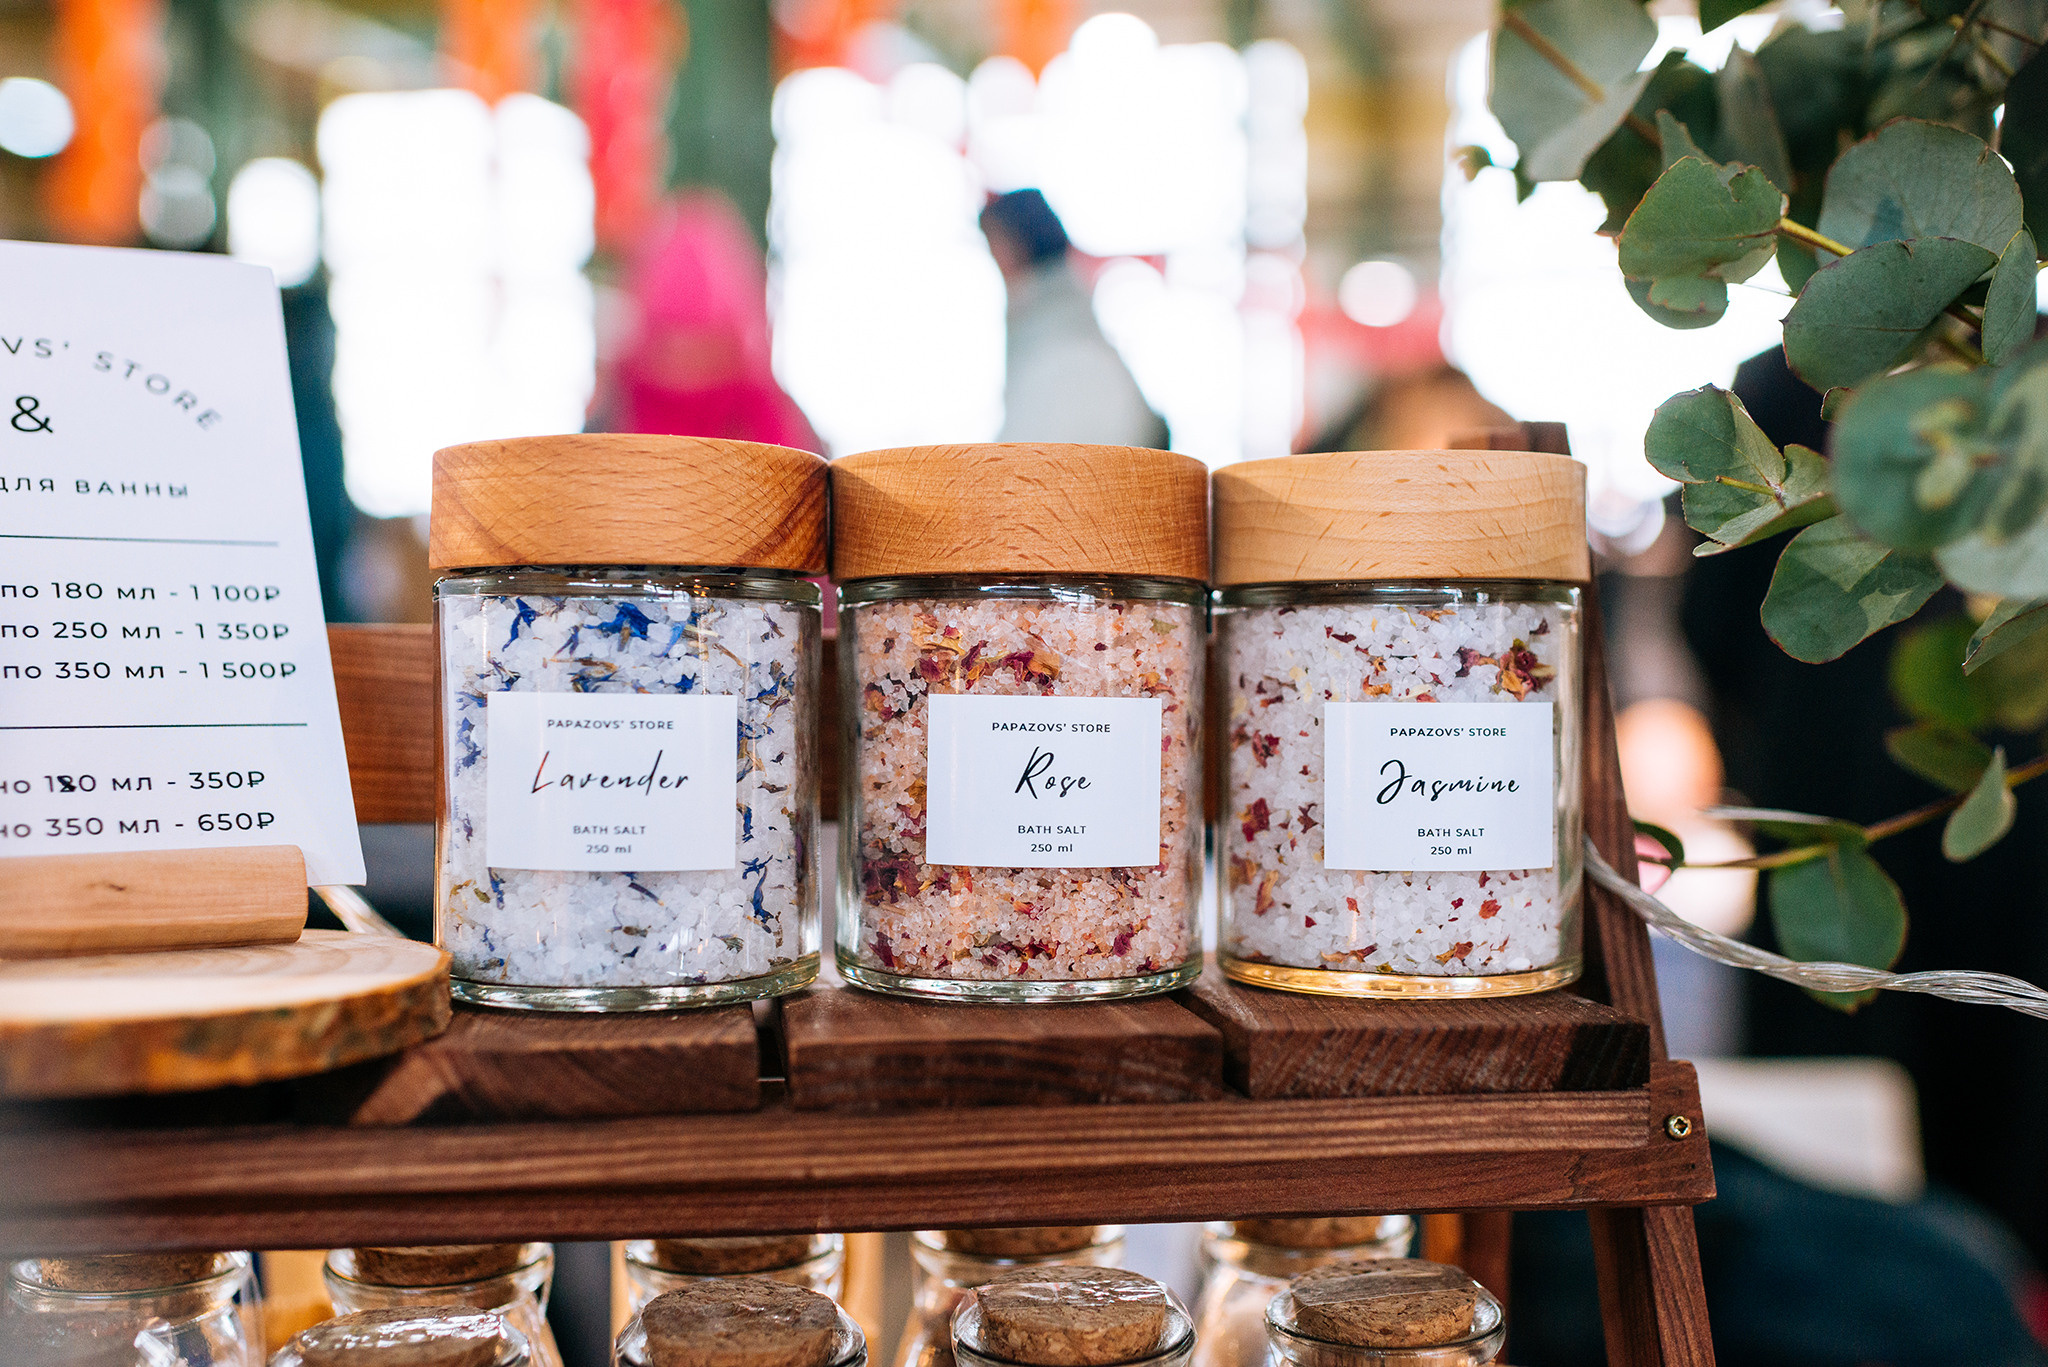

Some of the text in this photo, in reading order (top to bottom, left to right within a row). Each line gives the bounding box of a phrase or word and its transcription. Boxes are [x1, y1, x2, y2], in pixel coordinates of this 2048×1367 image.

[93, 351, 222, 431] STORE
[9, 394, 55, 435] &
[0, 584, 40, 599] по
[50, 581, 104, 600] 180
[116, 586, 156, 601] мл
[0, 624, 40, 639] по
[51, 621, 108, 640] 250
[121, 625, 161, 640] мл
[2, 665, 42, 680] по
[54, 661, 111, 680] 350
[124, 665, 165, 680] мл
[546, 718, 674, 731] PAPAZOVS' STORE
[991, 721, 1111, 734] PAPAZOVS' STORE
[1389, 727, 1507, 738] PAPAZOVS' STORE
[530, 748, 690, 797] Lavender
[1014, 745, 1092, 800] Rose
[111, 776, 153, 792] мл
[1375, 758, 1521, 805] Jasmine
[44, 816, 104, 838] 350
[118, 818, 161, 835] мл
[572, 824, 647, 836] BATH SALT
[1017, 824, 1087, 835] BATH SALT
[1417, 827, 1486, 838] BATH SALT
[585, 844, 632, 854] 250 ml
[1030, 842, 1073, 853] 250 ml
[1430, 845, 1472, 856] 250 ml
